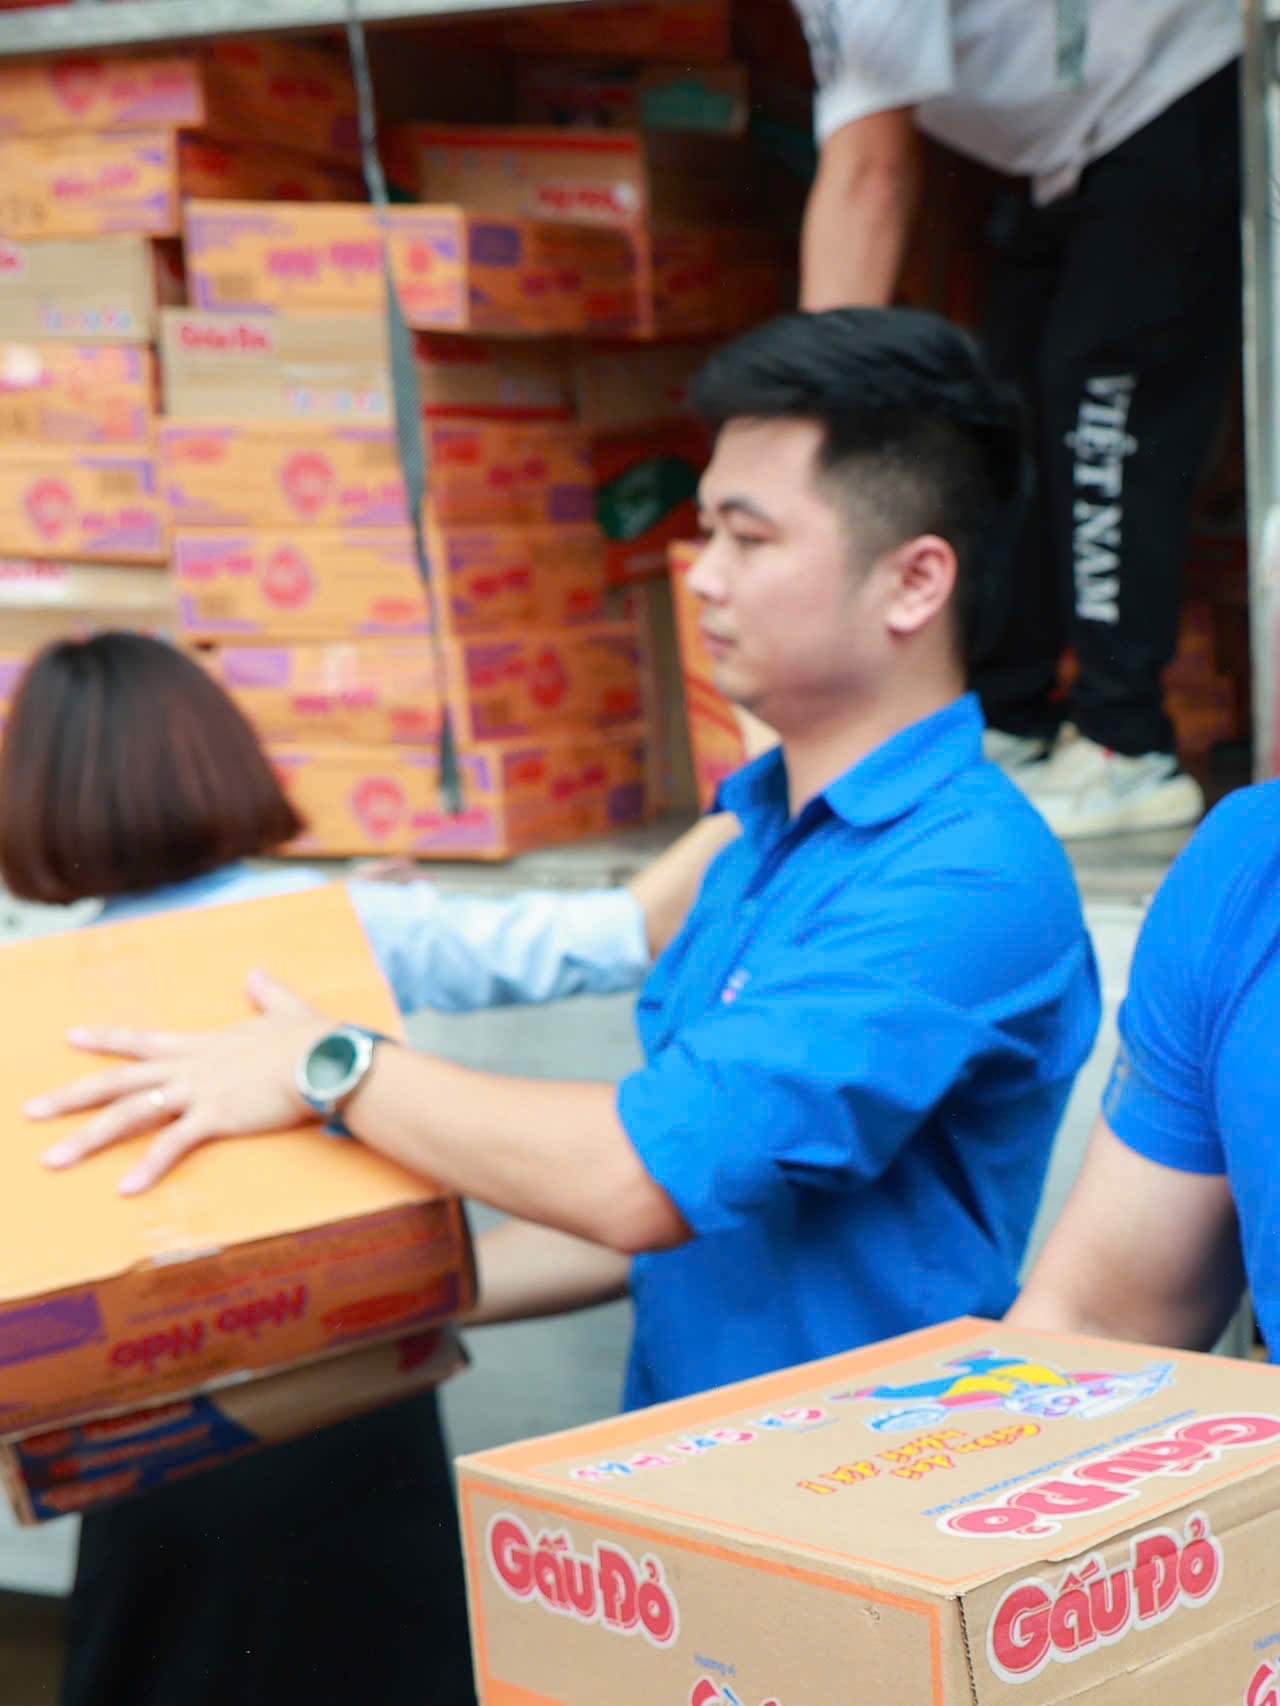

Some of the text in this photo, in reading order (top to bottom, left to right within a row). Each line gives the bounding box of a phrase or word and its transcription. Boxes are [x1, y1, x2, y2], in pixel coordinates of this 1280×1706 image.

[1064, 373, 1138, 625] VIỆT NAM
[944, 1480, 1136, 1536] Đỏ
[490, 1518, 678, 1644] Gấu Đỏ
[990, 1516, 1220, 1676] Gấu Đỏ
